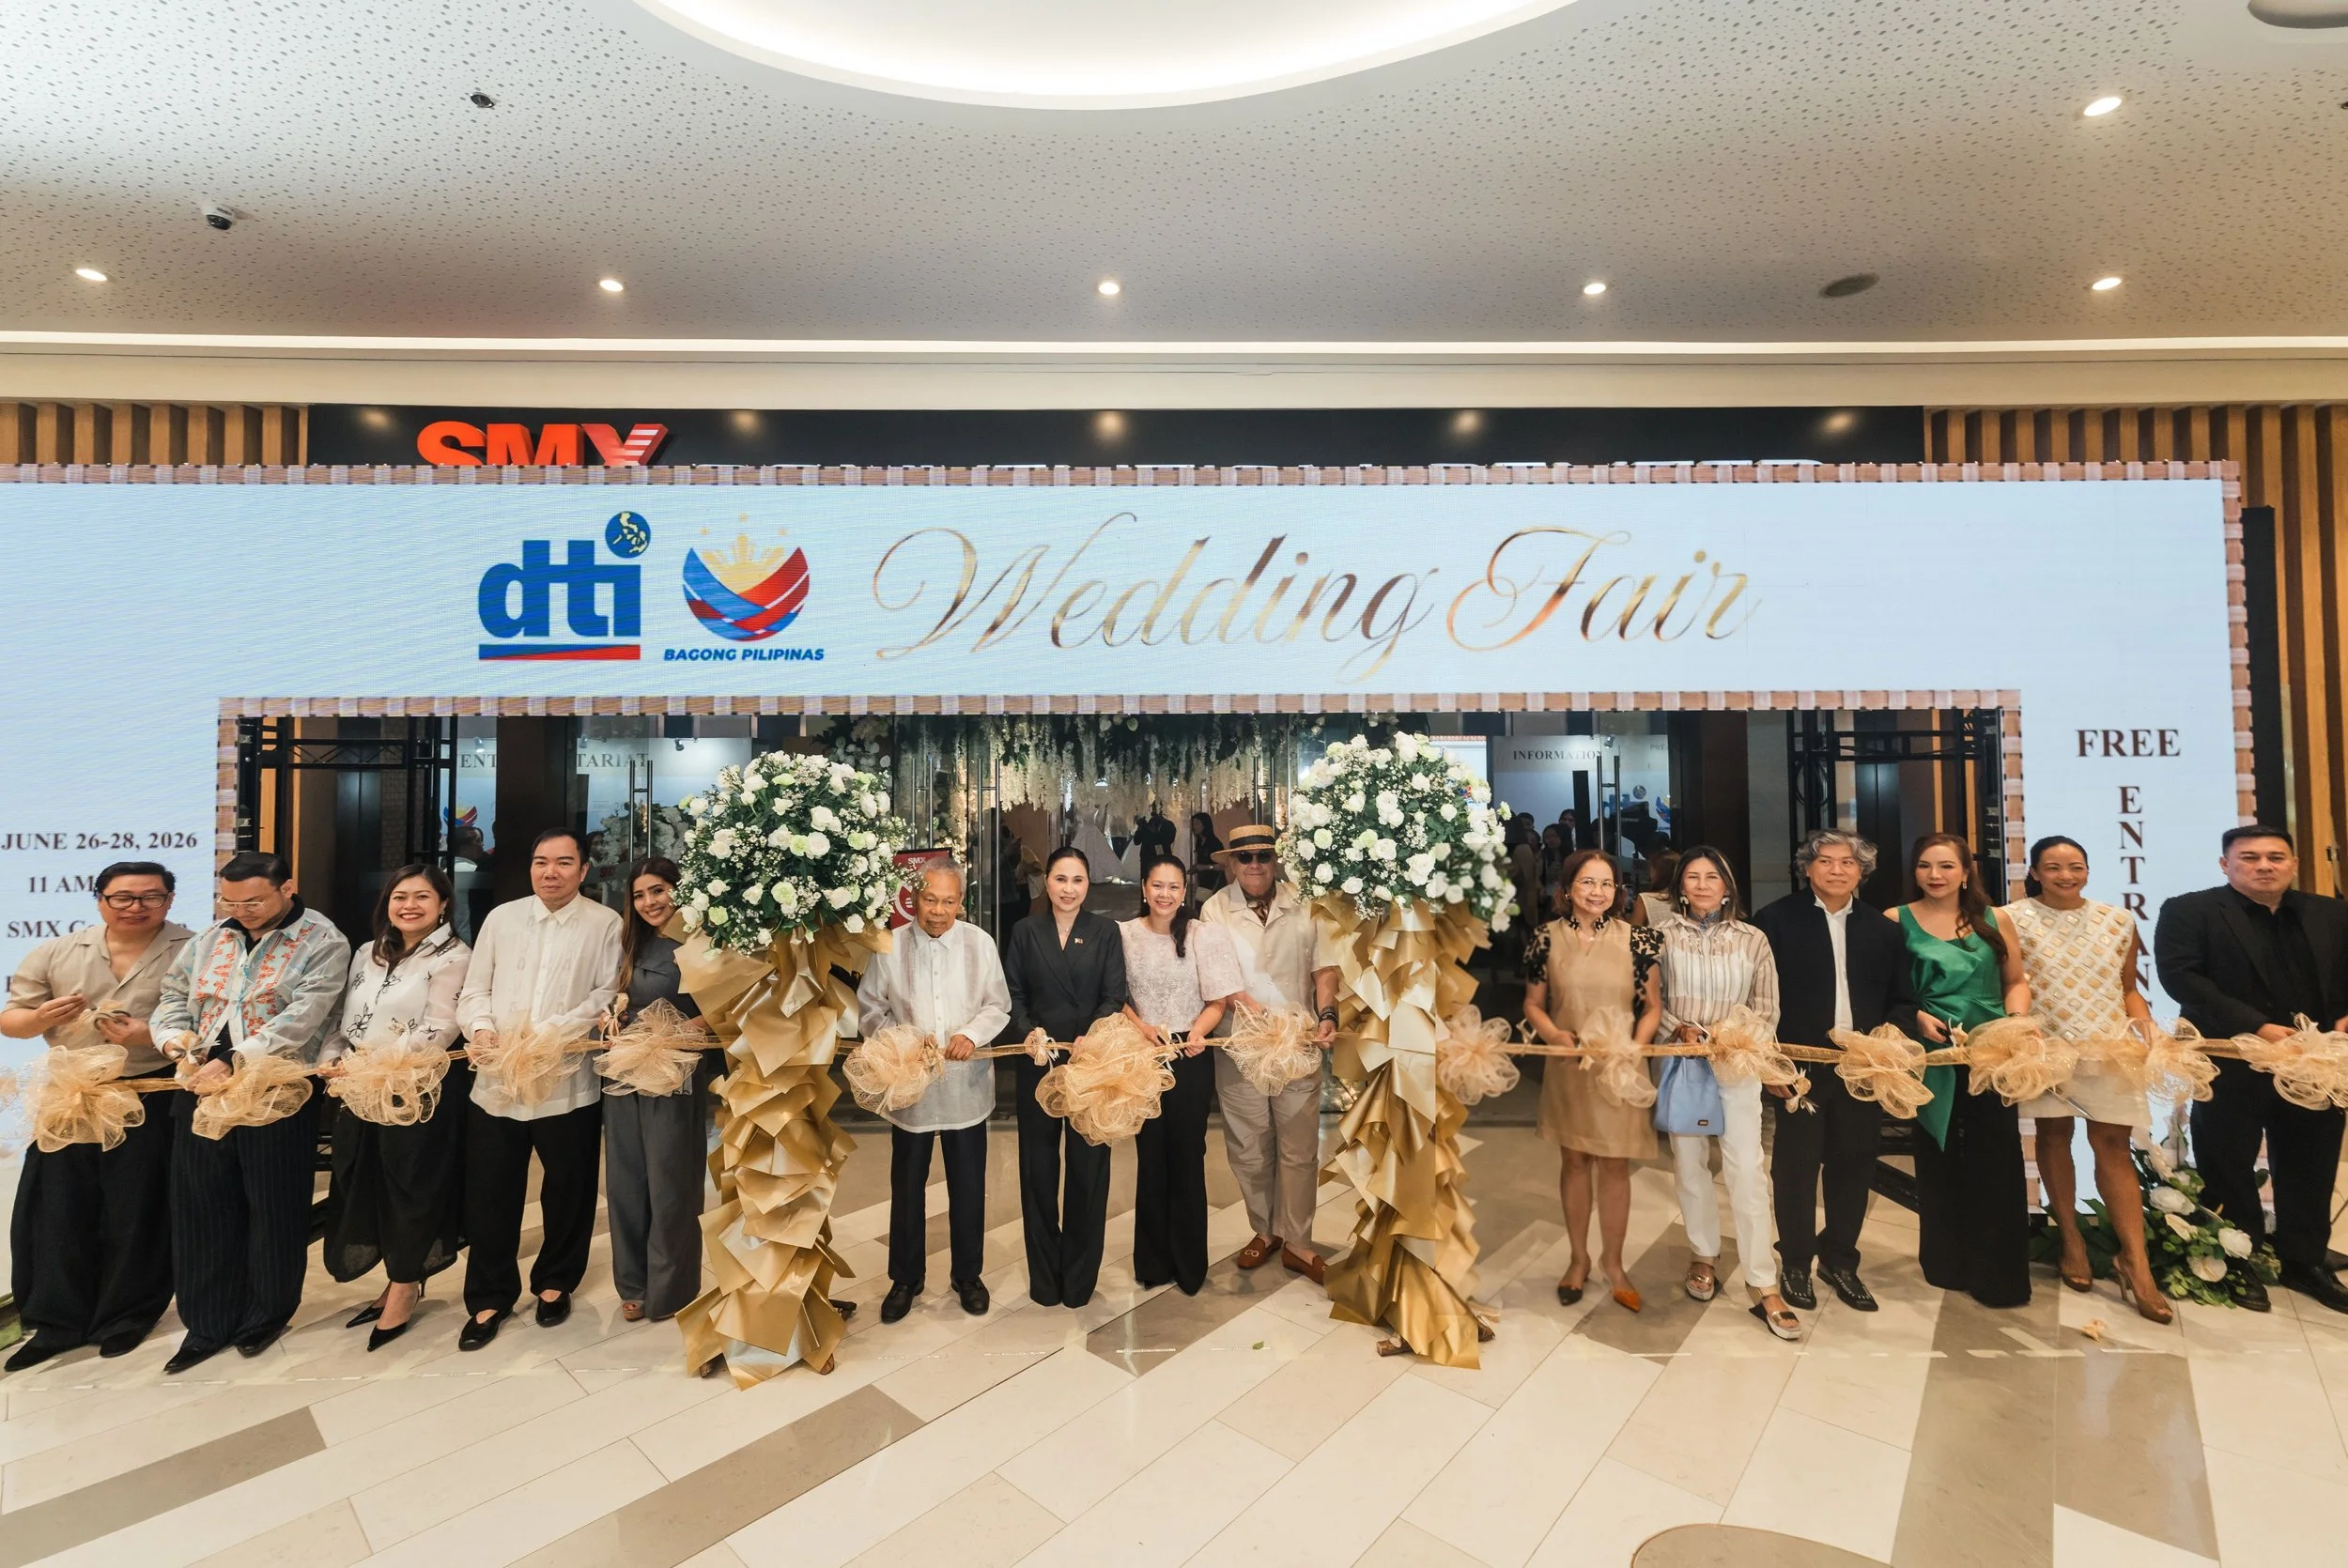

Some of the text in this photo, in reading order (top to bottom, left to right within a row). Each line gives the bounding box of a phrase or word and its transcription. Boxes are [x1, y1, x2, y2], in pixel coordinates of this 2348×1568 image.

[873, 512, 1763, 684] Wedding Fair
[664, 649, 825, 661] BAGONG PILIPINAS
[2077, 729, 2181, 757] FREE
[577, 753, 649, 767] TARIAT
[1, 832, 197, 852] JUNE 26-28, 2026
[29, 876, 47, 892] 11
[8, 920, 60, 938] SMX
